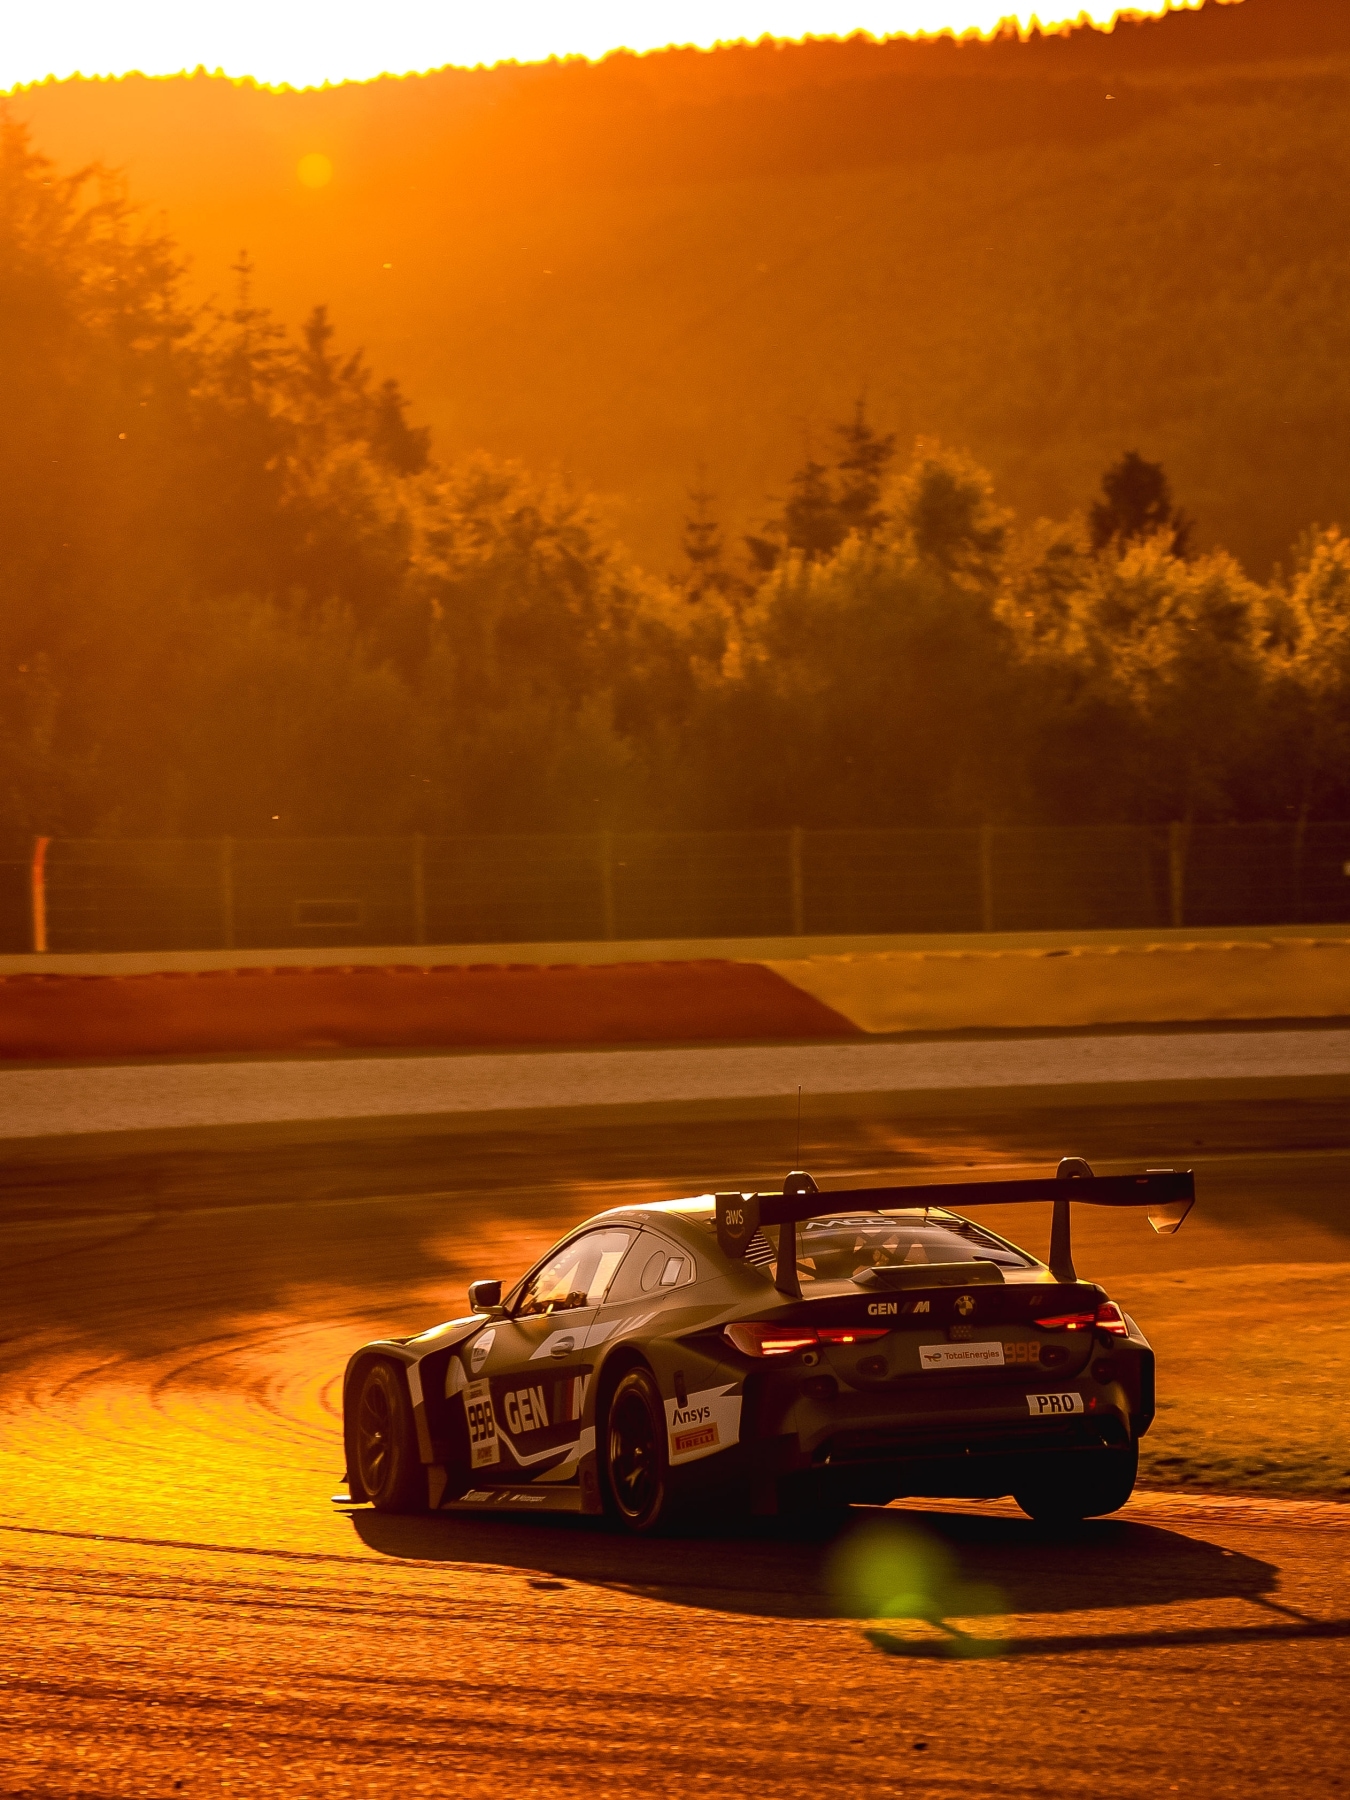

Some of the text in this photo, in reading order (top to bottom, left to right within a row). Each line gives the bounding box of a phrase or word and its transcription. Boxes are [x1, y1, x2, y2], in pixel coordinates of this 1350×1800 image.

[725, 1209, 744, 1225] aws
[867, 1302, 898, 1316] GEN
[944, 1349, 1000, 1360] TotalEnergies
[1004, 1341, 1040, 1363] 998
[503, 1385, 550, 1435] GEN
[1036, 1394, 1075, 1413] PRO
[468, 1400, 495, 1443] 998
[672, 1406, 711, 1426] Ansys
[675, 1427, 715, 1451] PIRELLI
